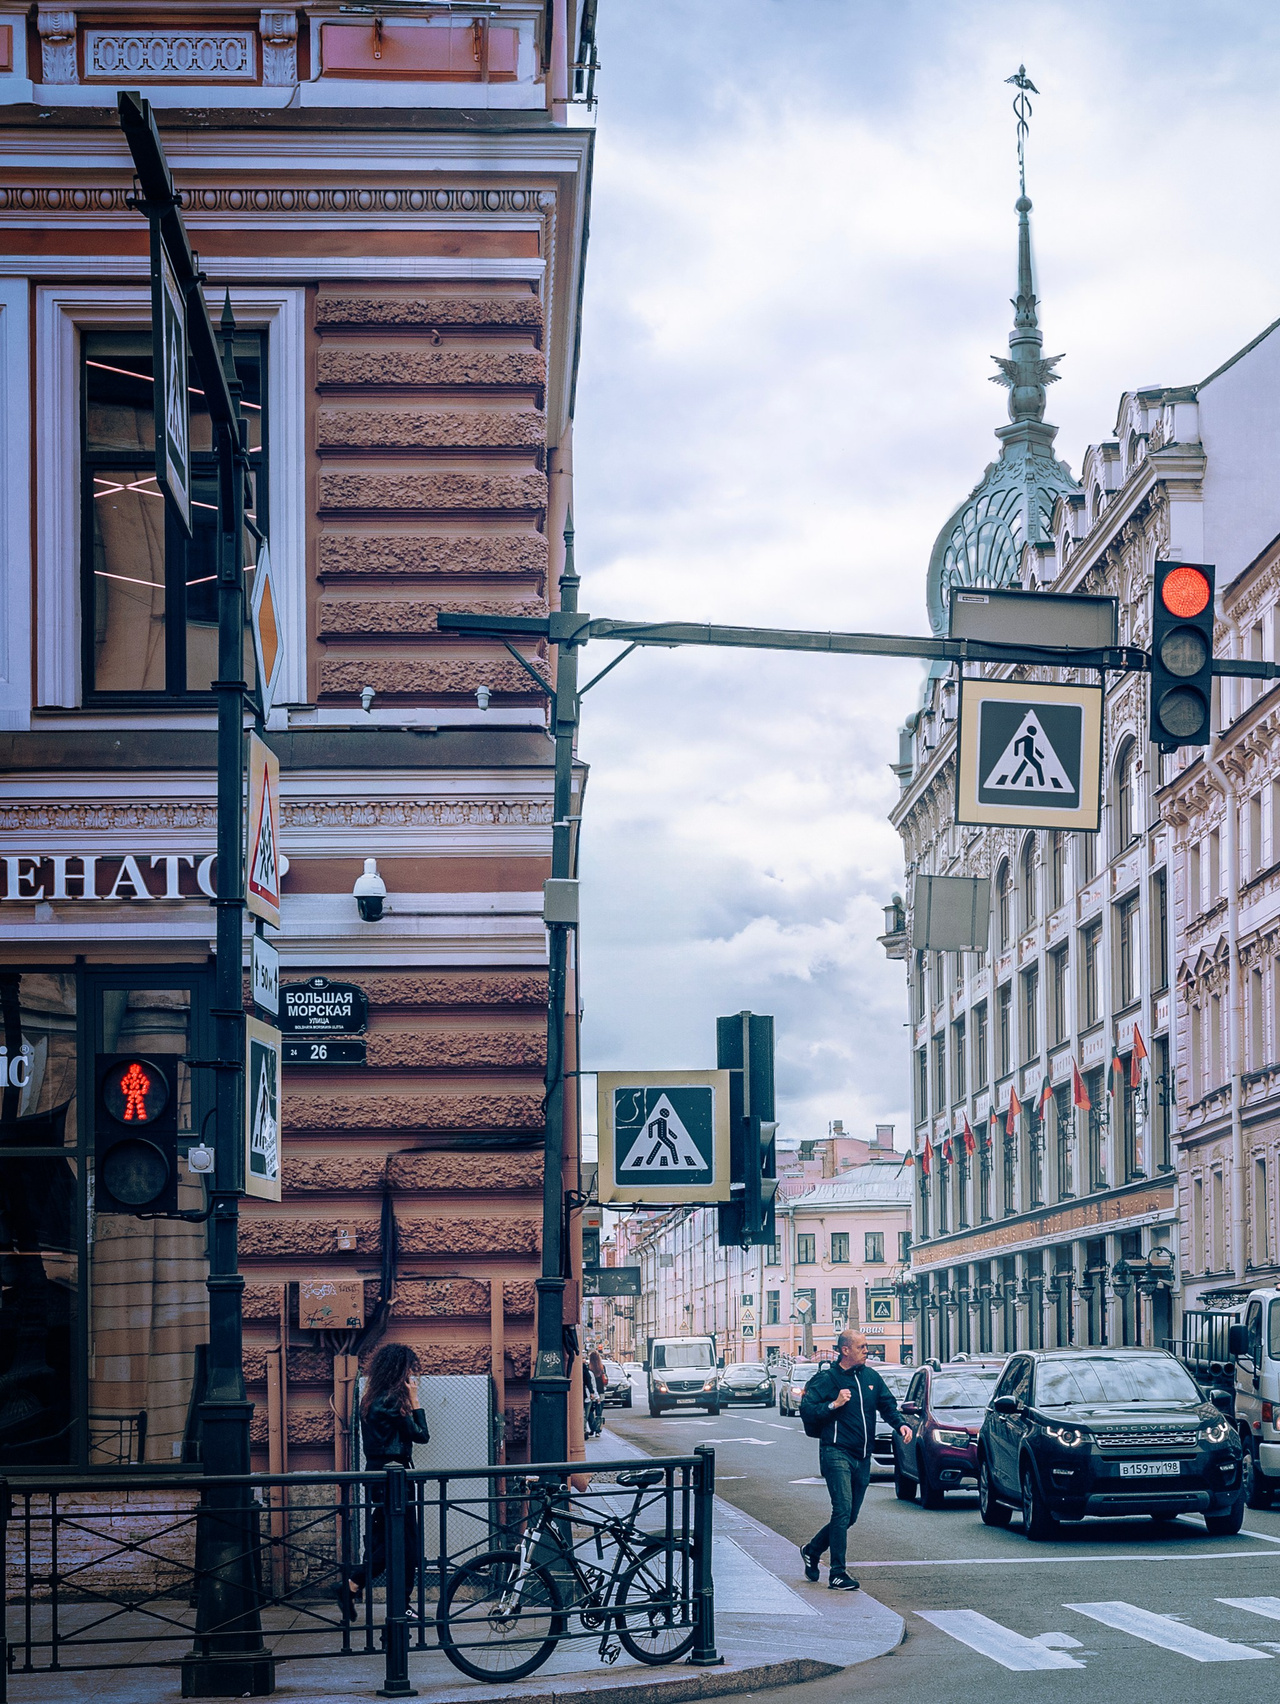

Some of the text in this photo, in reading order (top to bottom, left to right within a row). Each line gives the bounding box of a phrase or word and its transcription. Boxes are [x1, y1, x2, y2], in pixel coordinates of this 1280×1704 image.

[0, 855, 290, 900] ЕНАТ
[261, 965, 269, 990] 50
[286, 992, 353, 1004] БОЛЬШАЯ
[288, 1005, 351, 1016] МОРСКАЯ
[310, 1044, 327, 1059] 26
[1163, 1462, 1178, 1471] 198
